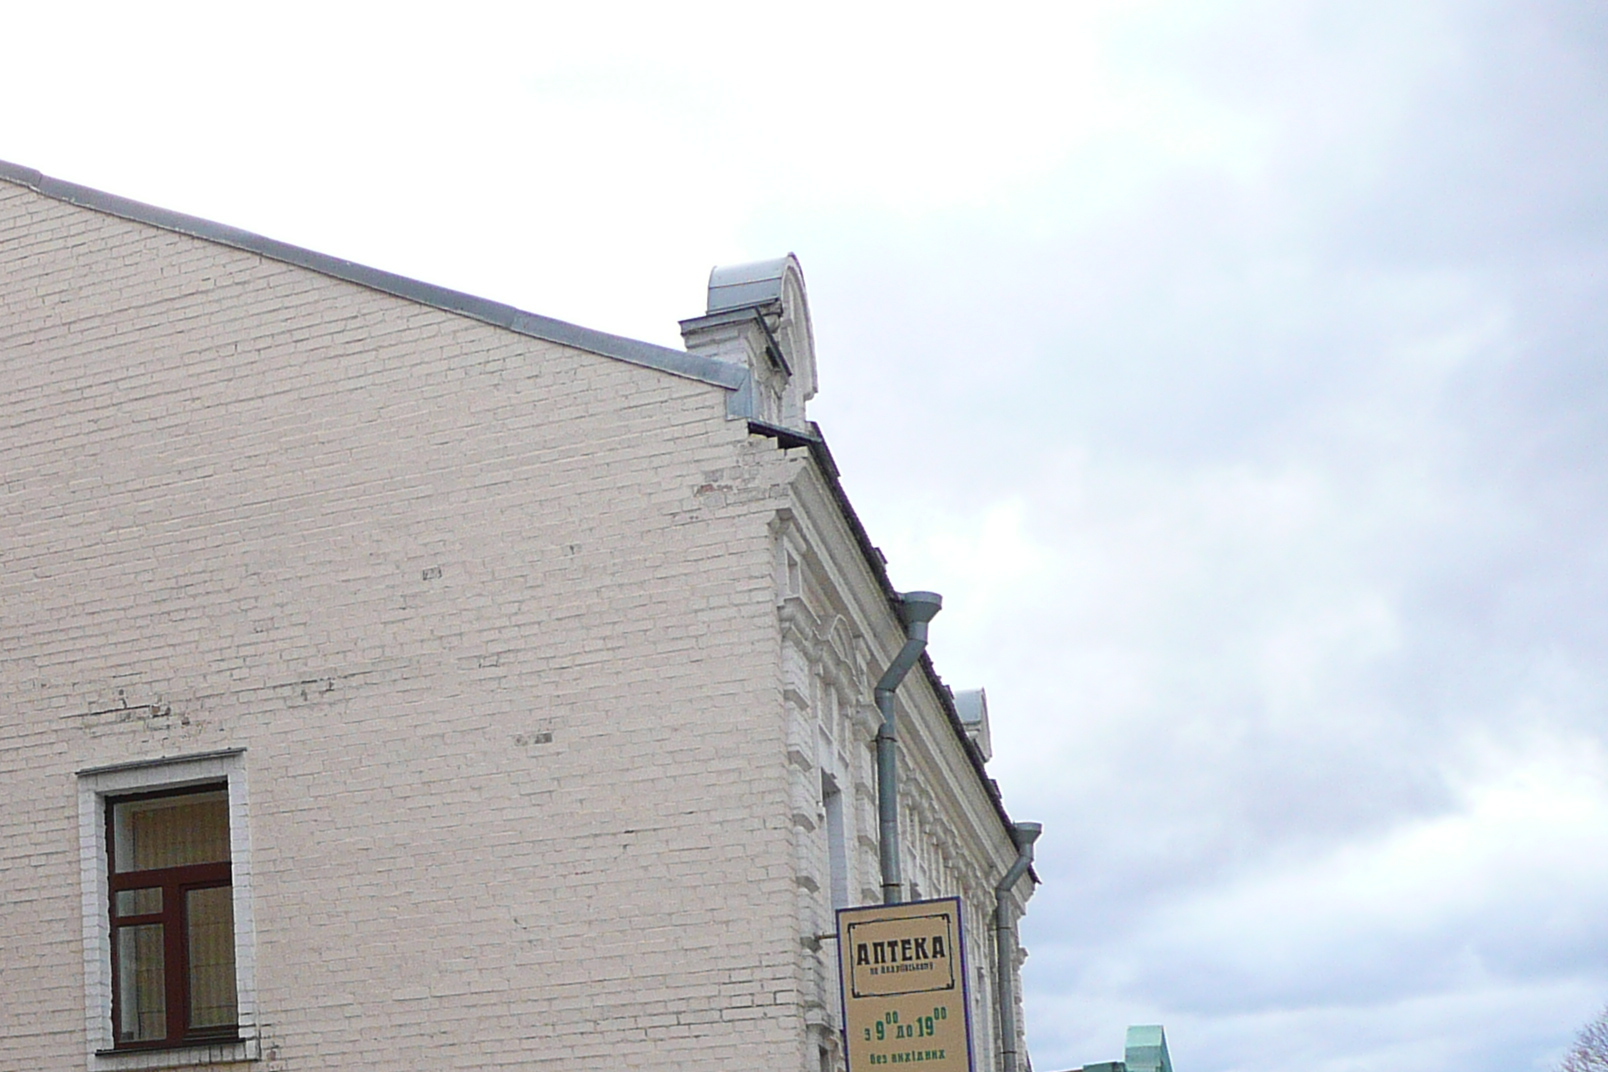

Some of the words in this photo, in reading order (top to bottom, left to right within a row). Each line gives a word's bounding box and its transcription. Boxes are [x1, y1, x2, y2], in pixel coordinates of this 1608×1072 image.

[856, 935, 946, 966] АПТЕКА
[896, 1024, 913, 1039] до
[869, 1053, 888, 1065] без
